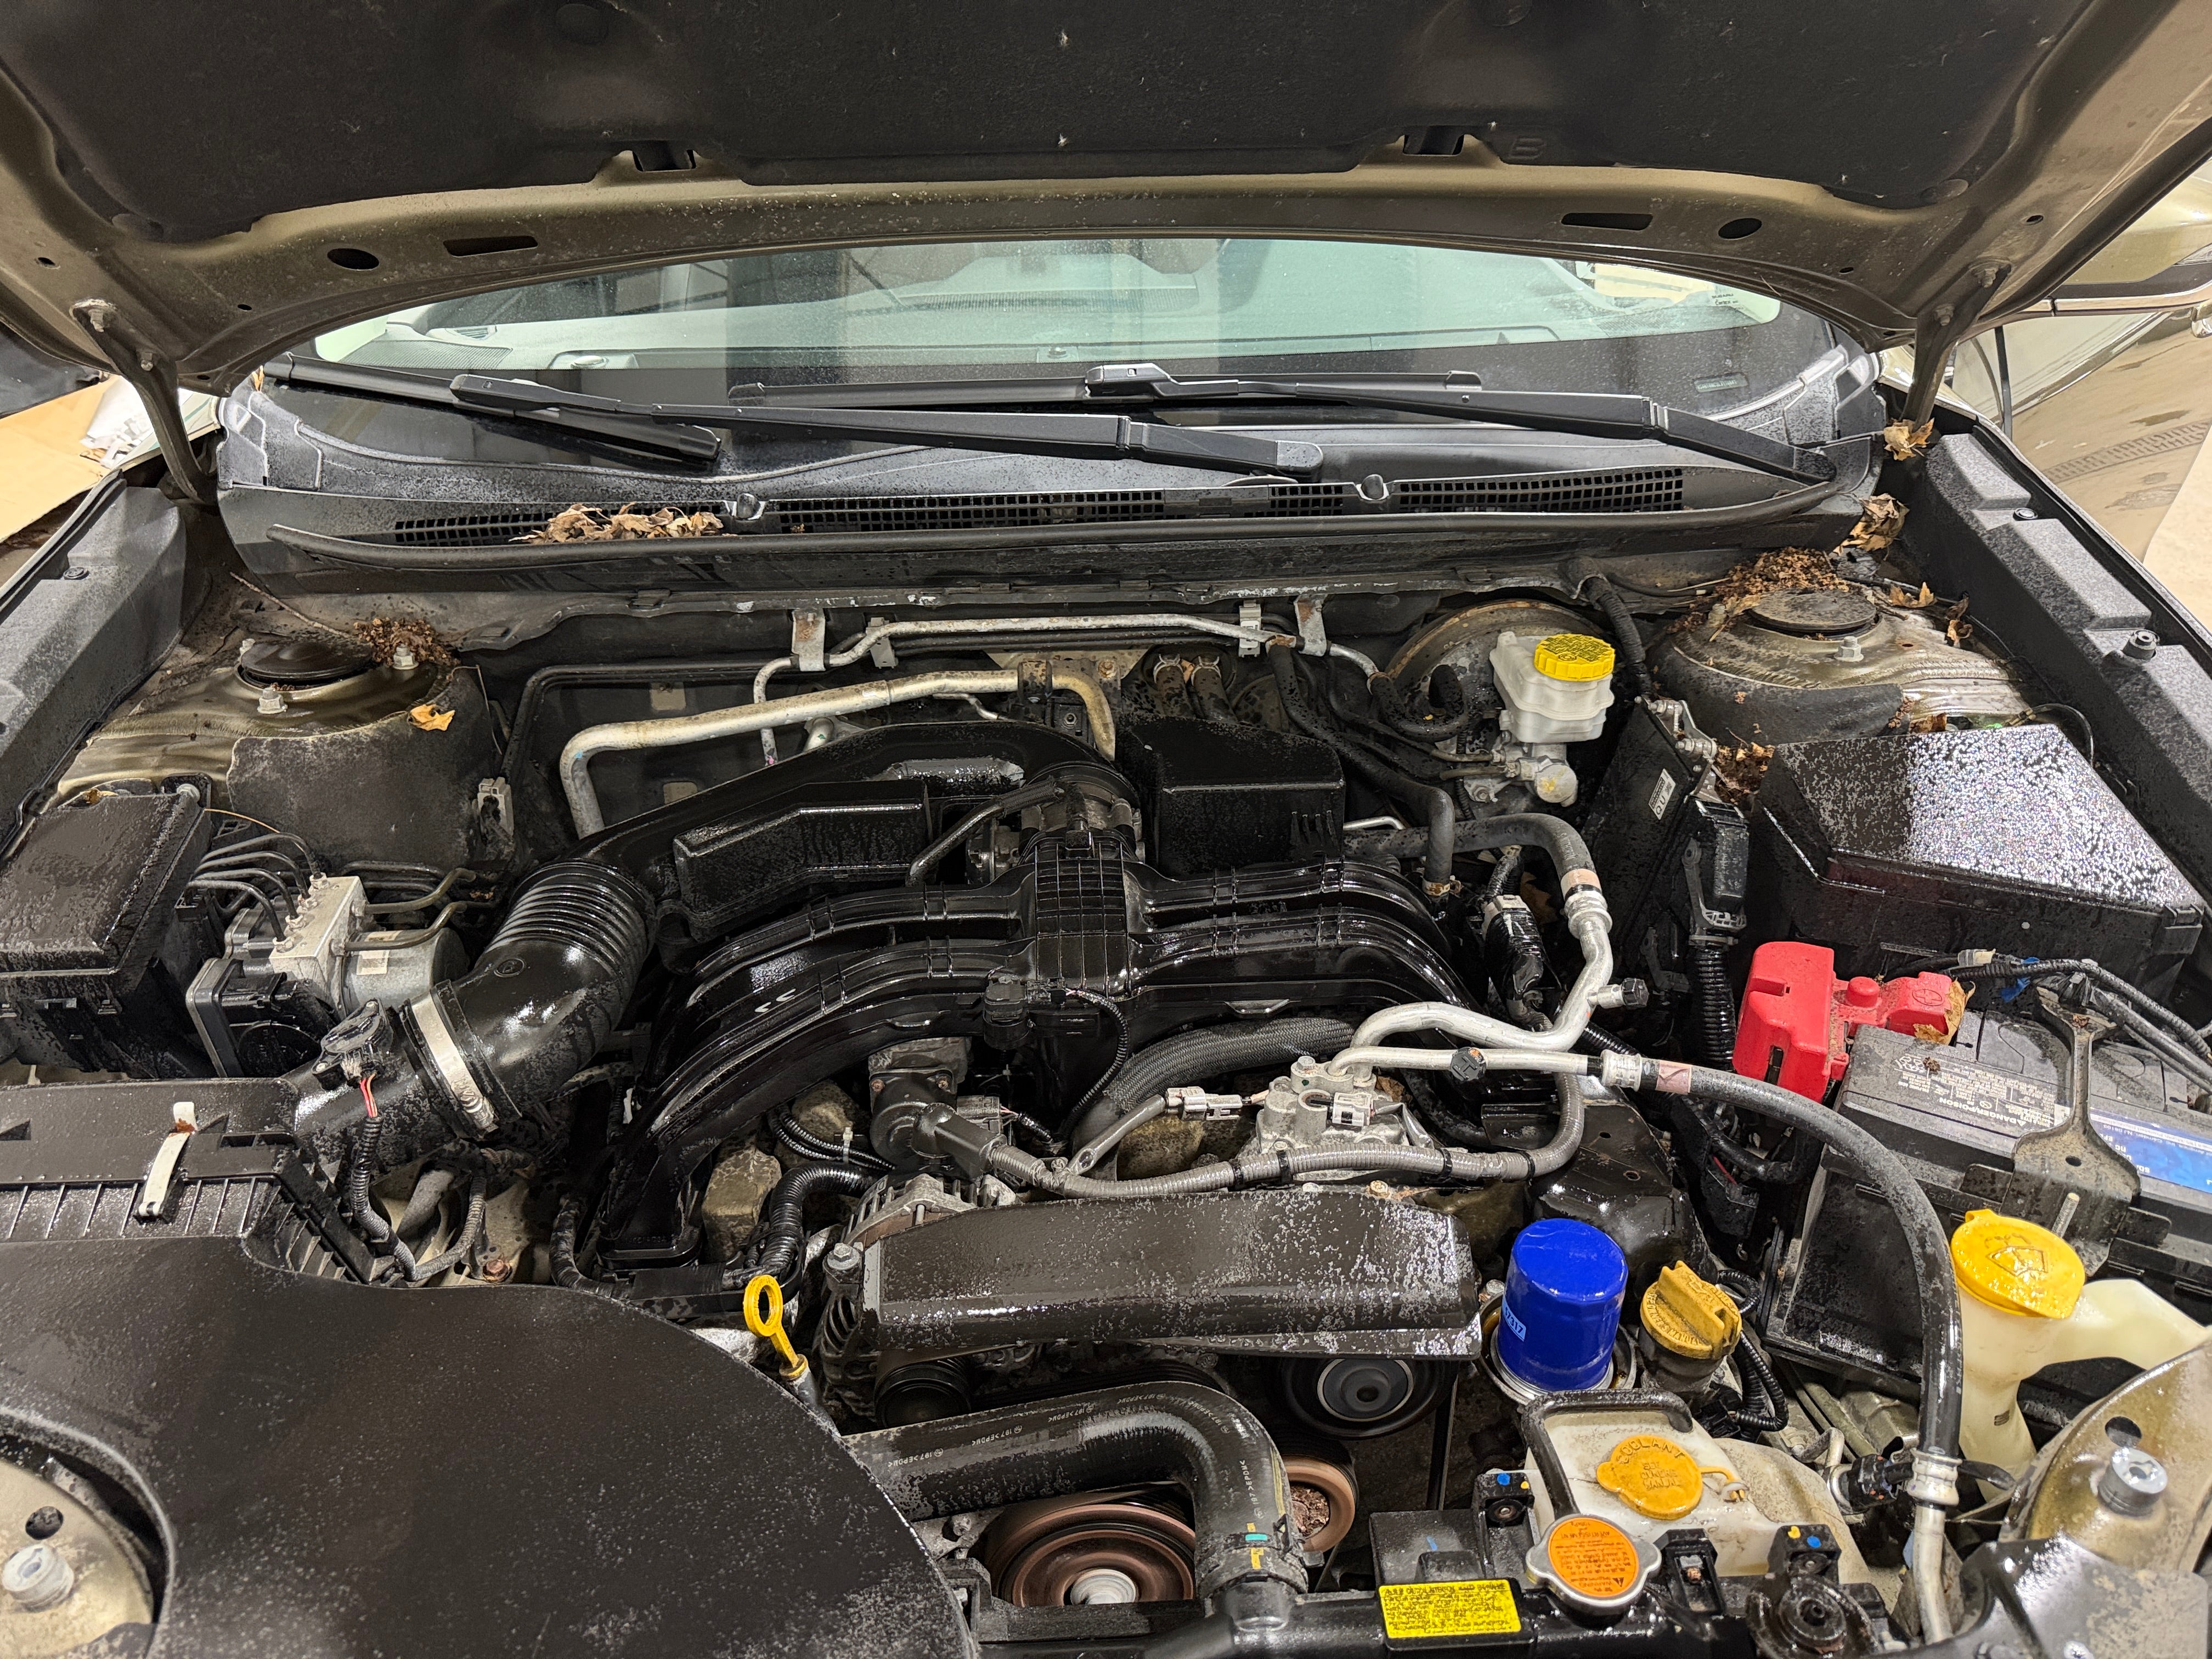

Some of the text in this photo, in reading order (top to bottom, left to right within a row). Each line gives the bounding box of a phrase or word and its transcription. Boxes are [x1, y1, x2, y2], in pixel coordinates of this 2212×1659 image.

[1939, 1097, 2017, 1124] DANGER/POISON
[1667, 1329, 1702, 1346] MANUAL
[1616, 1438, 1685, 1464] COOLANT
